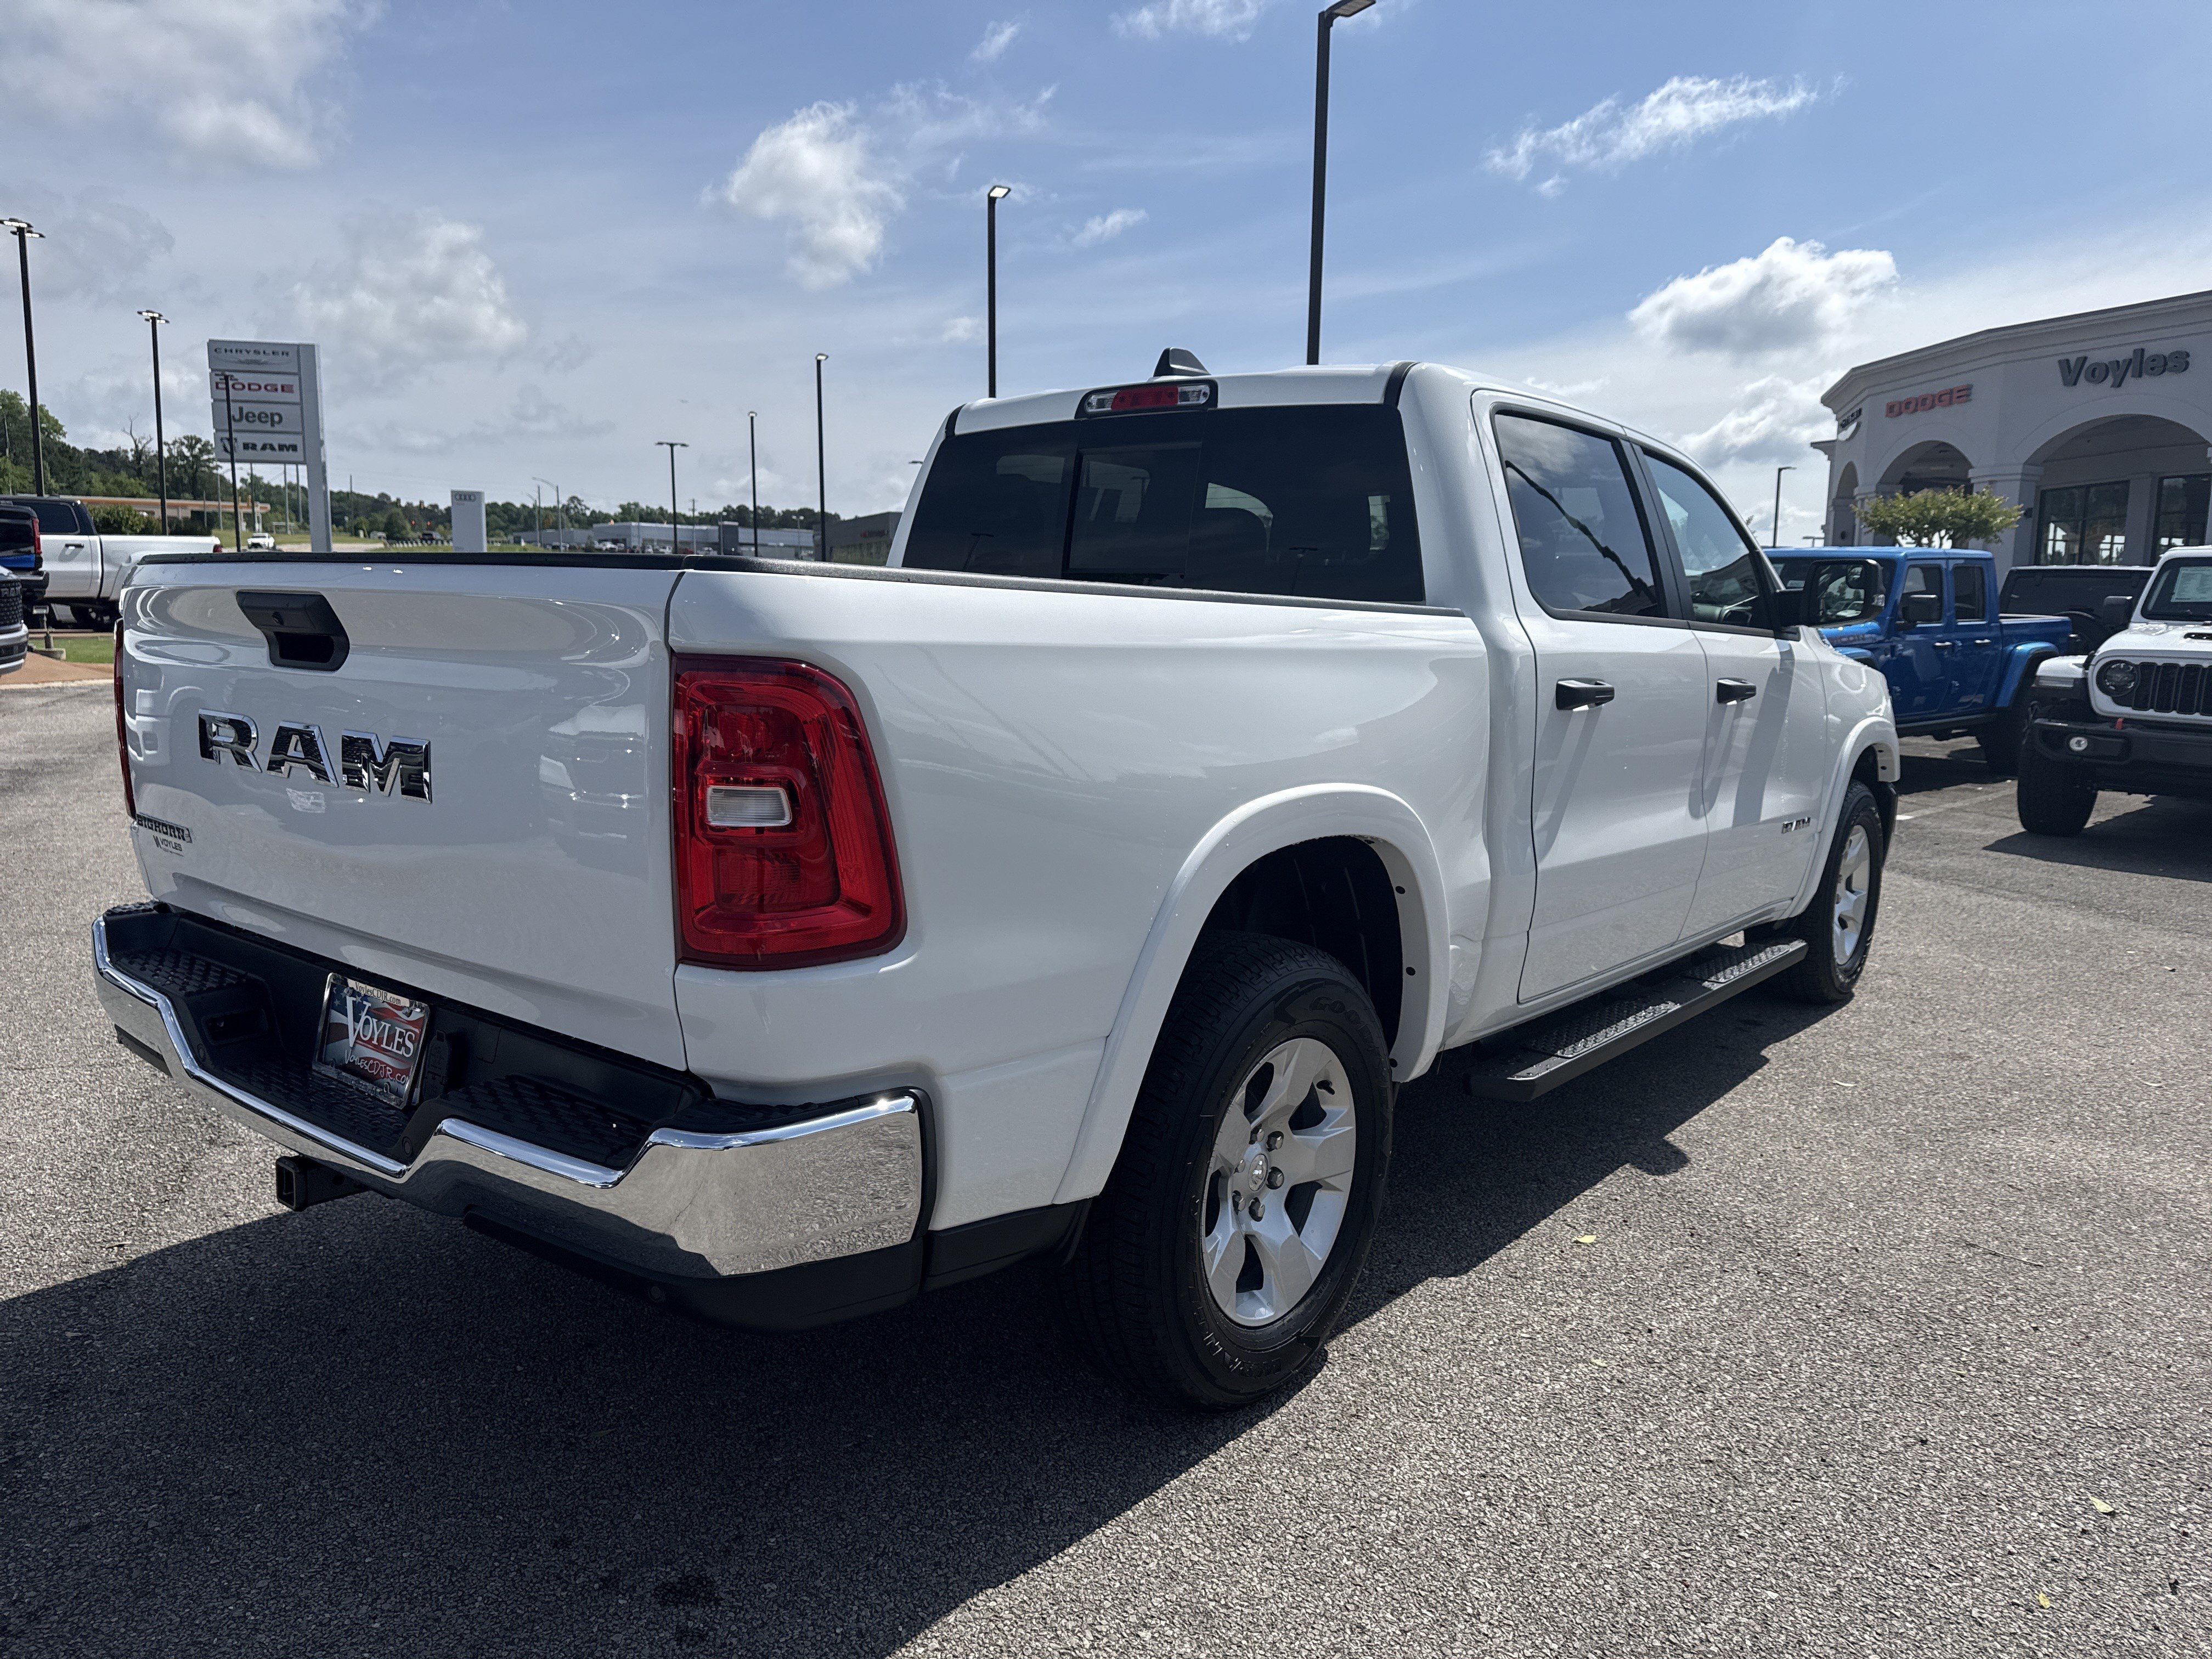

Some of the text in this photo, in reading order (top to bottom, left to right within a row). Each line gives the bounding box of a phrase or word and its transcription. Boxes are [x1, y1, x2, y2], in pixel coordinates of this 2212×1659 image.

[215, 347, 289, 356] CHRYSLER
[2058, 348, 2190, 388] Voyles
[215, 381, 294, 393] DODGE
[1885, 384, 1973, 418] DODGE
[232, 406, 283, 427] Jeep
[242, 442, 298, 452] RAM
[199, 708, 432, 804] RAM
[1781, 816, 1810, 834] RAM
[355, 981, 401, 1006] VoylesCDJR.com
[346, 995, 415, 1057] VOYLES
